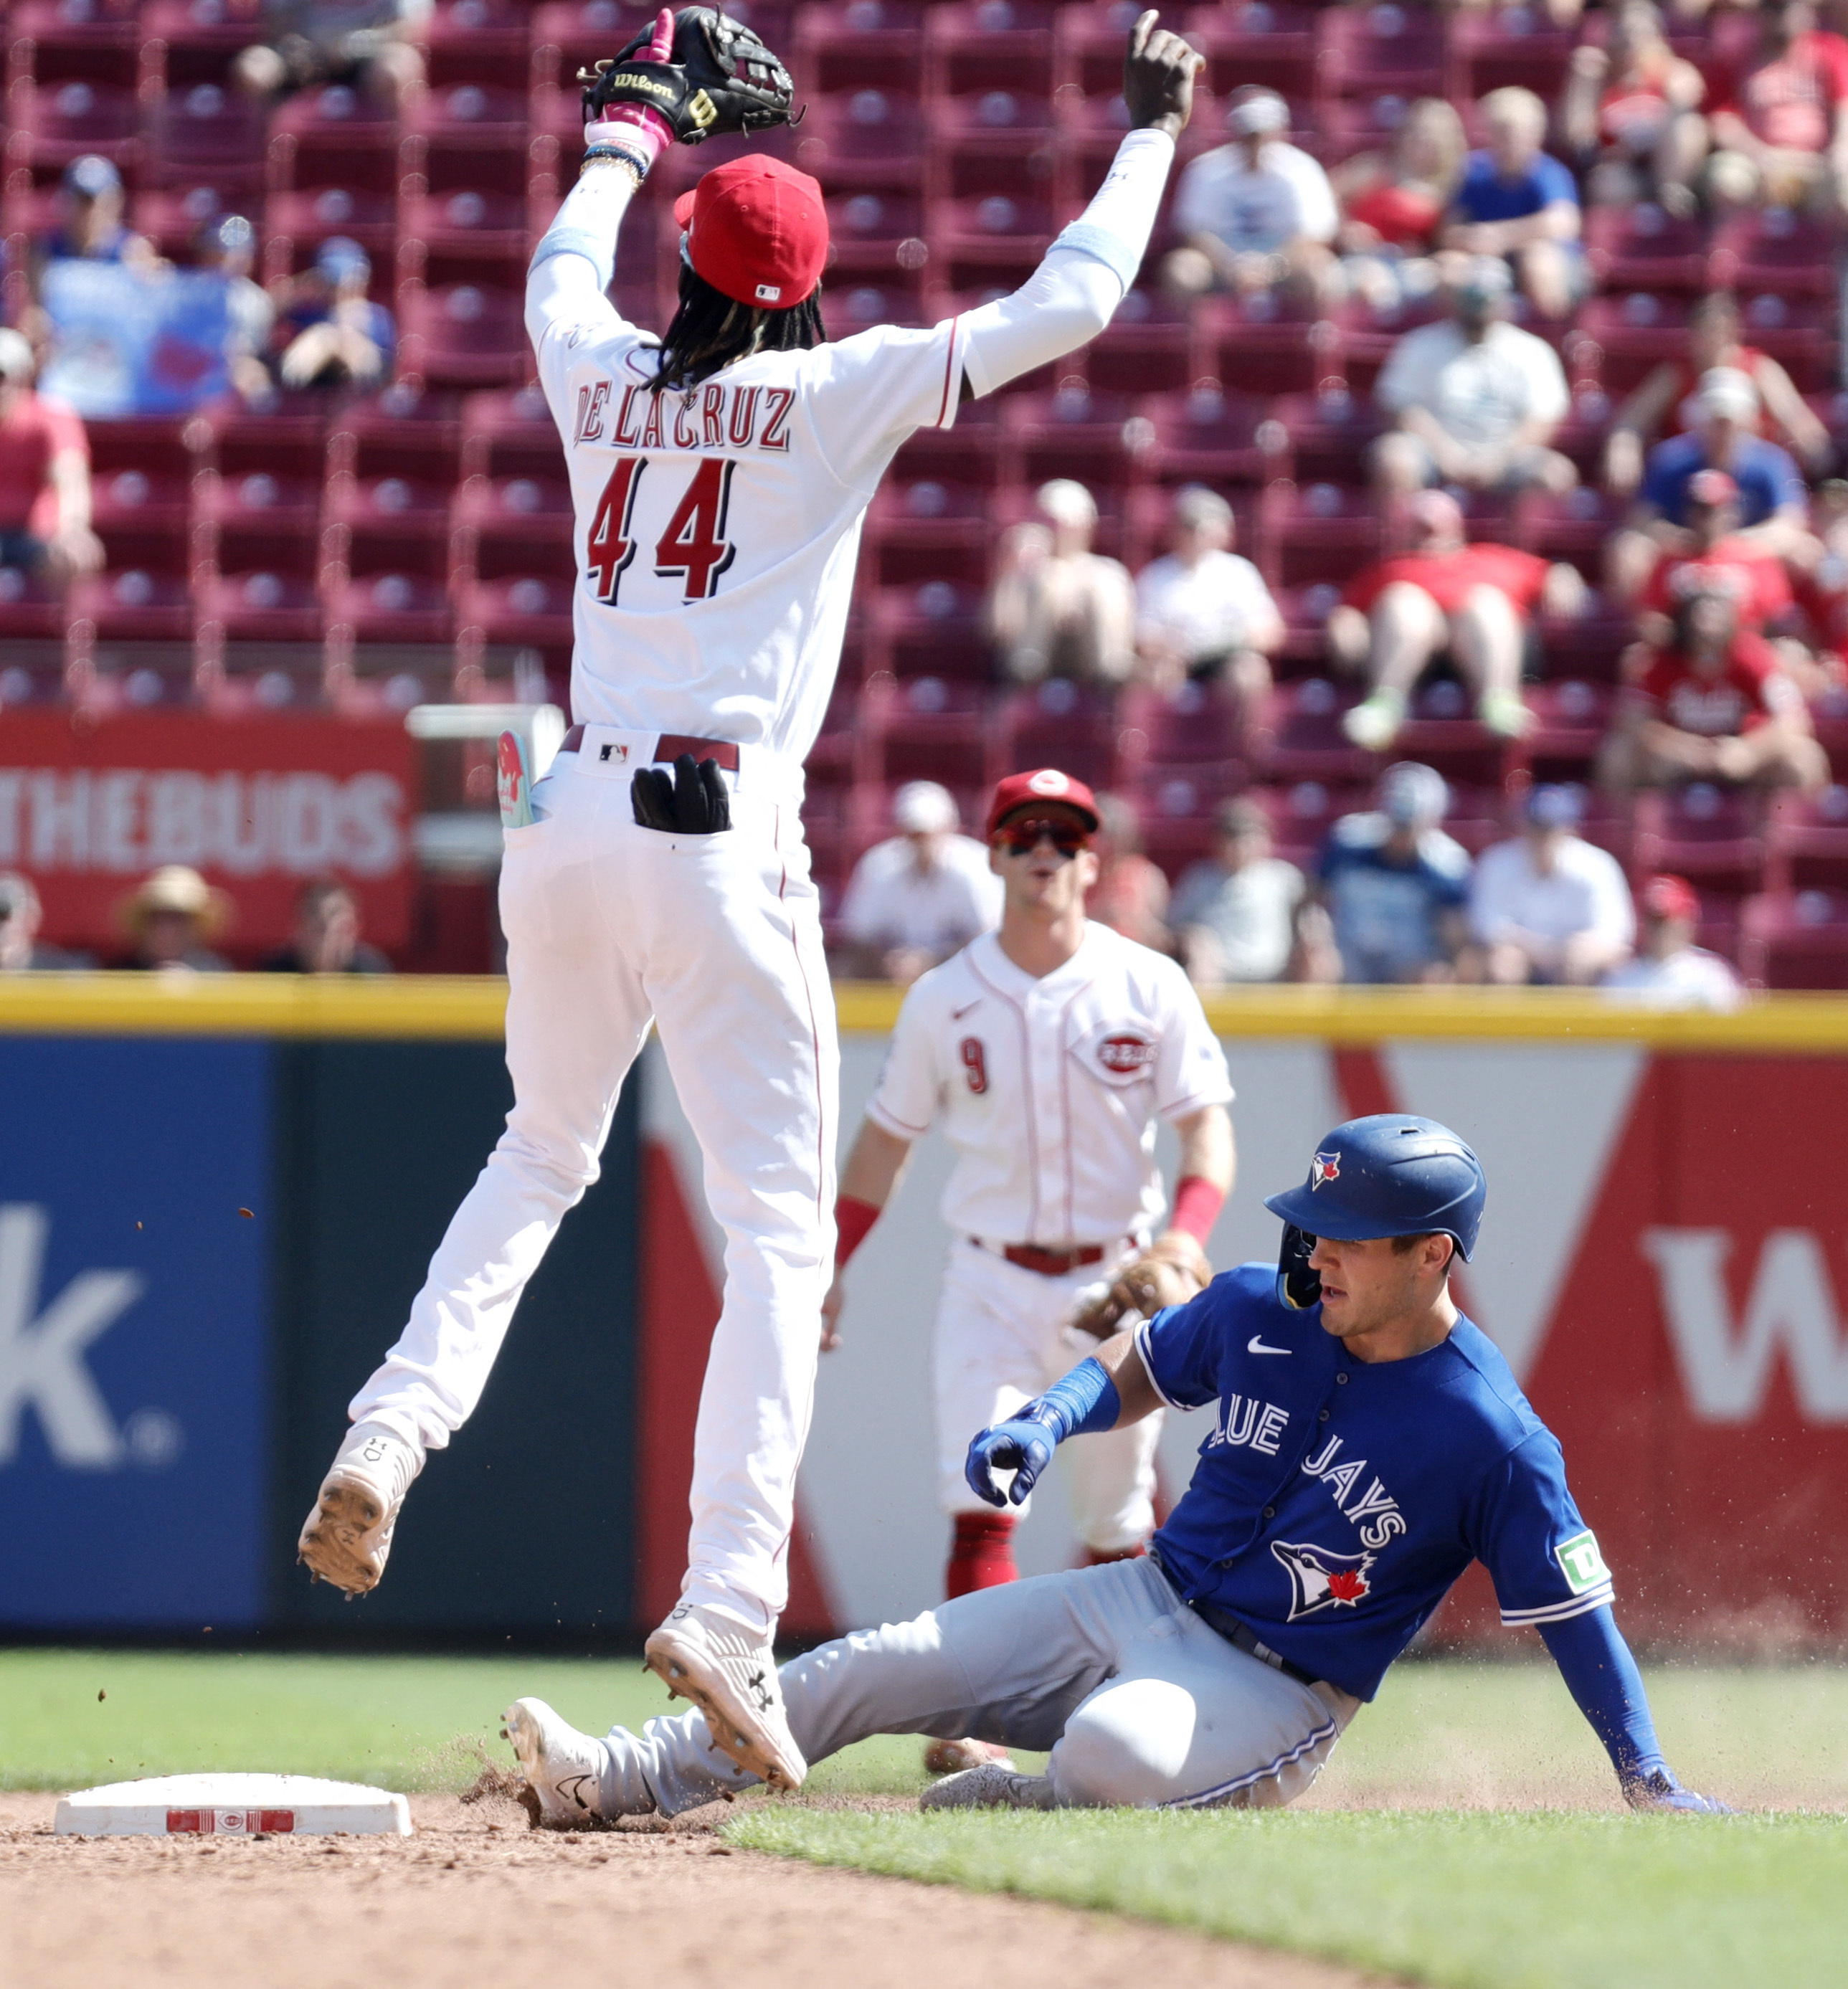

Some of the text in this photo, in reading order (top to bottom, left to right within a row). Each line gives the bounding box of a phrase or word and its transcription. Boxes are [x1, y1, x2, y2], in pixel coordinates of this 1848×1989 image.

[614, 73, 673, 100] Wilson
[573, 380, 796, 452] DE LA CRUZ
[586, 455, 738, 607] 44
[961, 1037, 987, 1093] 9
[1301, 1434, 1407, 1549] JAYS
